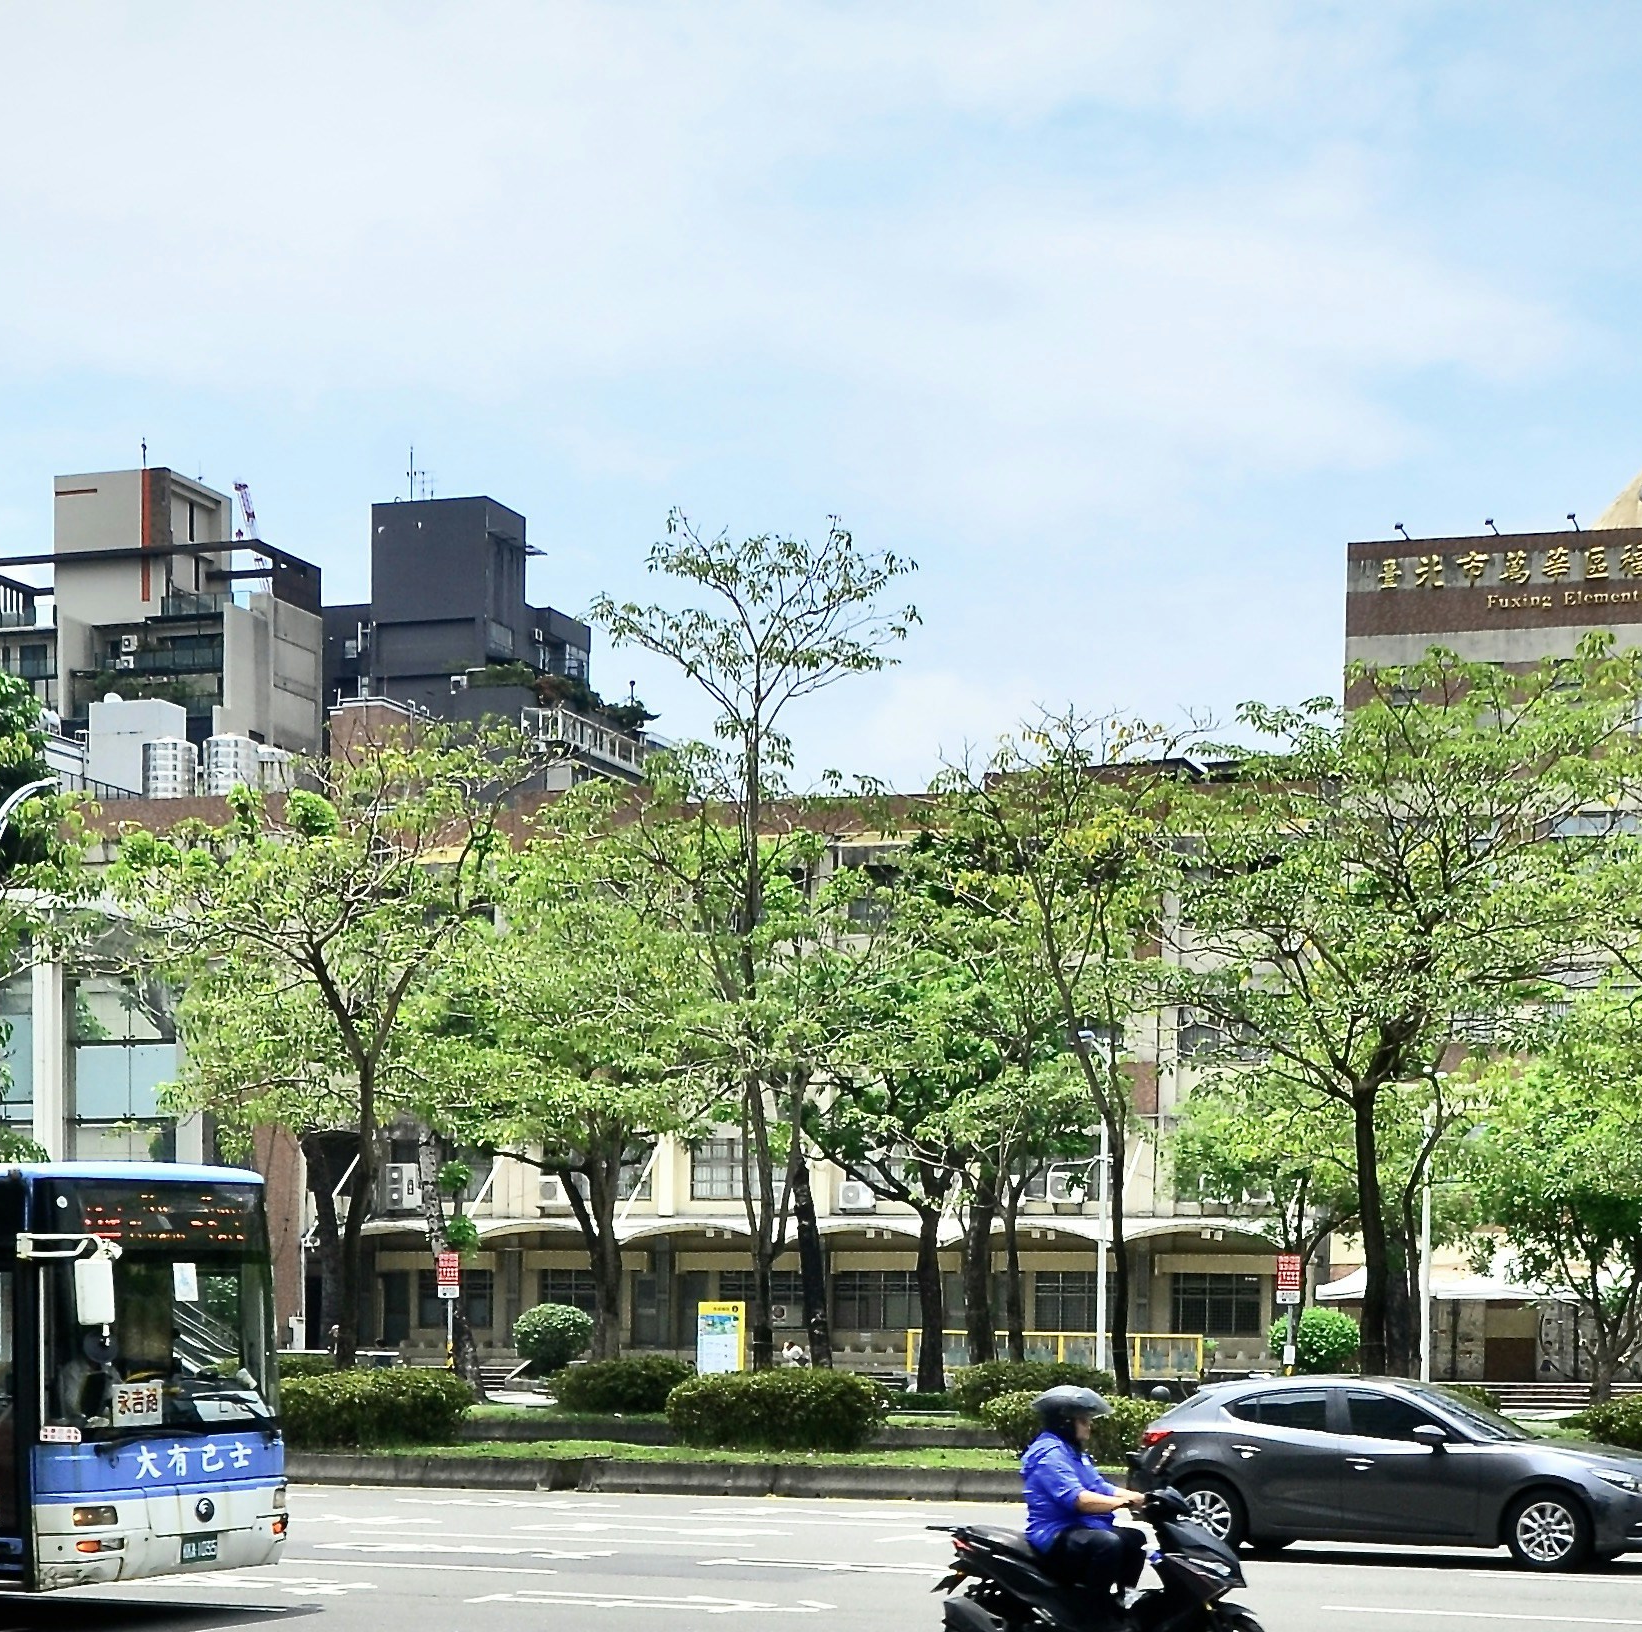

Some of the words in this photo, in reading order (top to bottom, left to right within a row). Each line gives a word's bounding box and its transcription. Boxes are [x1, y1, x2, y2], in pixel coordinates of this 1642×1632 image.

[1487, 593, 1552, 609] Fuxing
[135, 1441, 253, 1480] 大有巴士
